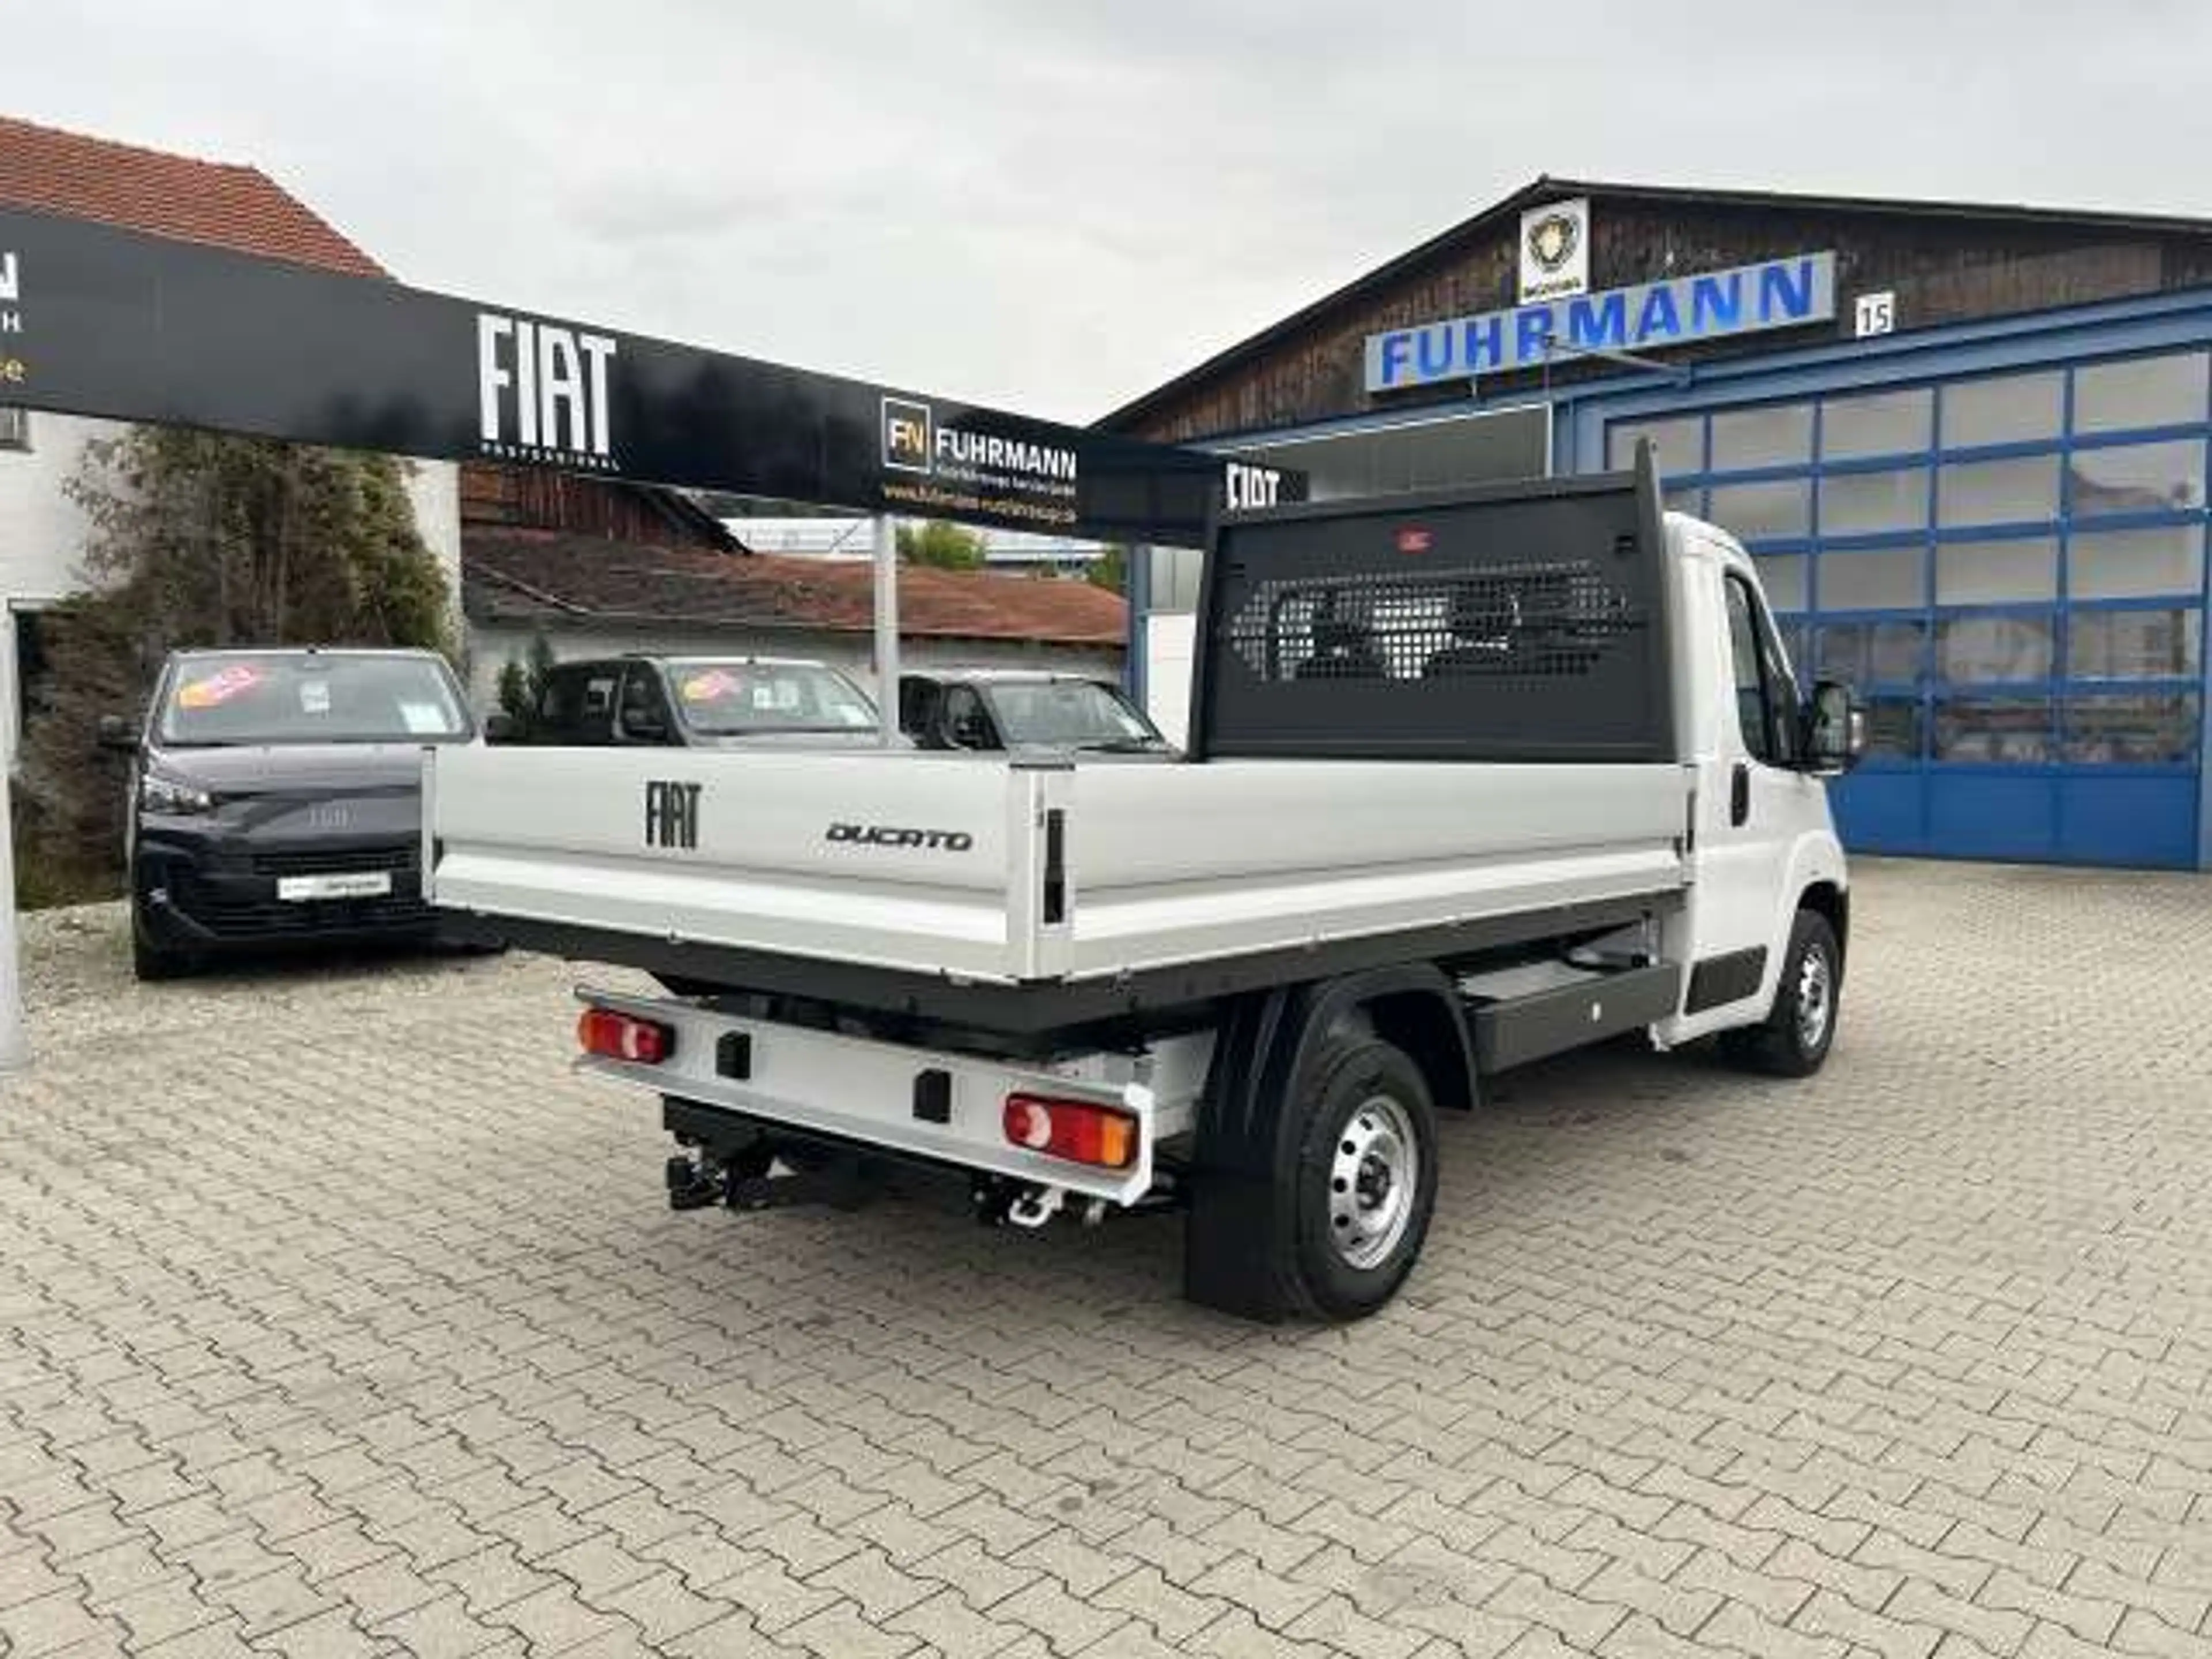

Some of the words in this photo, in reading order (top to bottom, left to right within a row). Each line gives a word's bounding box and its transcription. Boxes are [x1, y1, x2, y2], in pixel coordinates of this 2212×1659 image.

[1382, 260, 1813, 384] FUHRMANN
[1862, 304, 1888, 332] 15
[478, 313, 616, 455] FIAT
[935, 427, 1077, 480] FUHRMANN
[646, 780, 702, 850] FIAT
[825, 822, 974, 851] DUCATO
